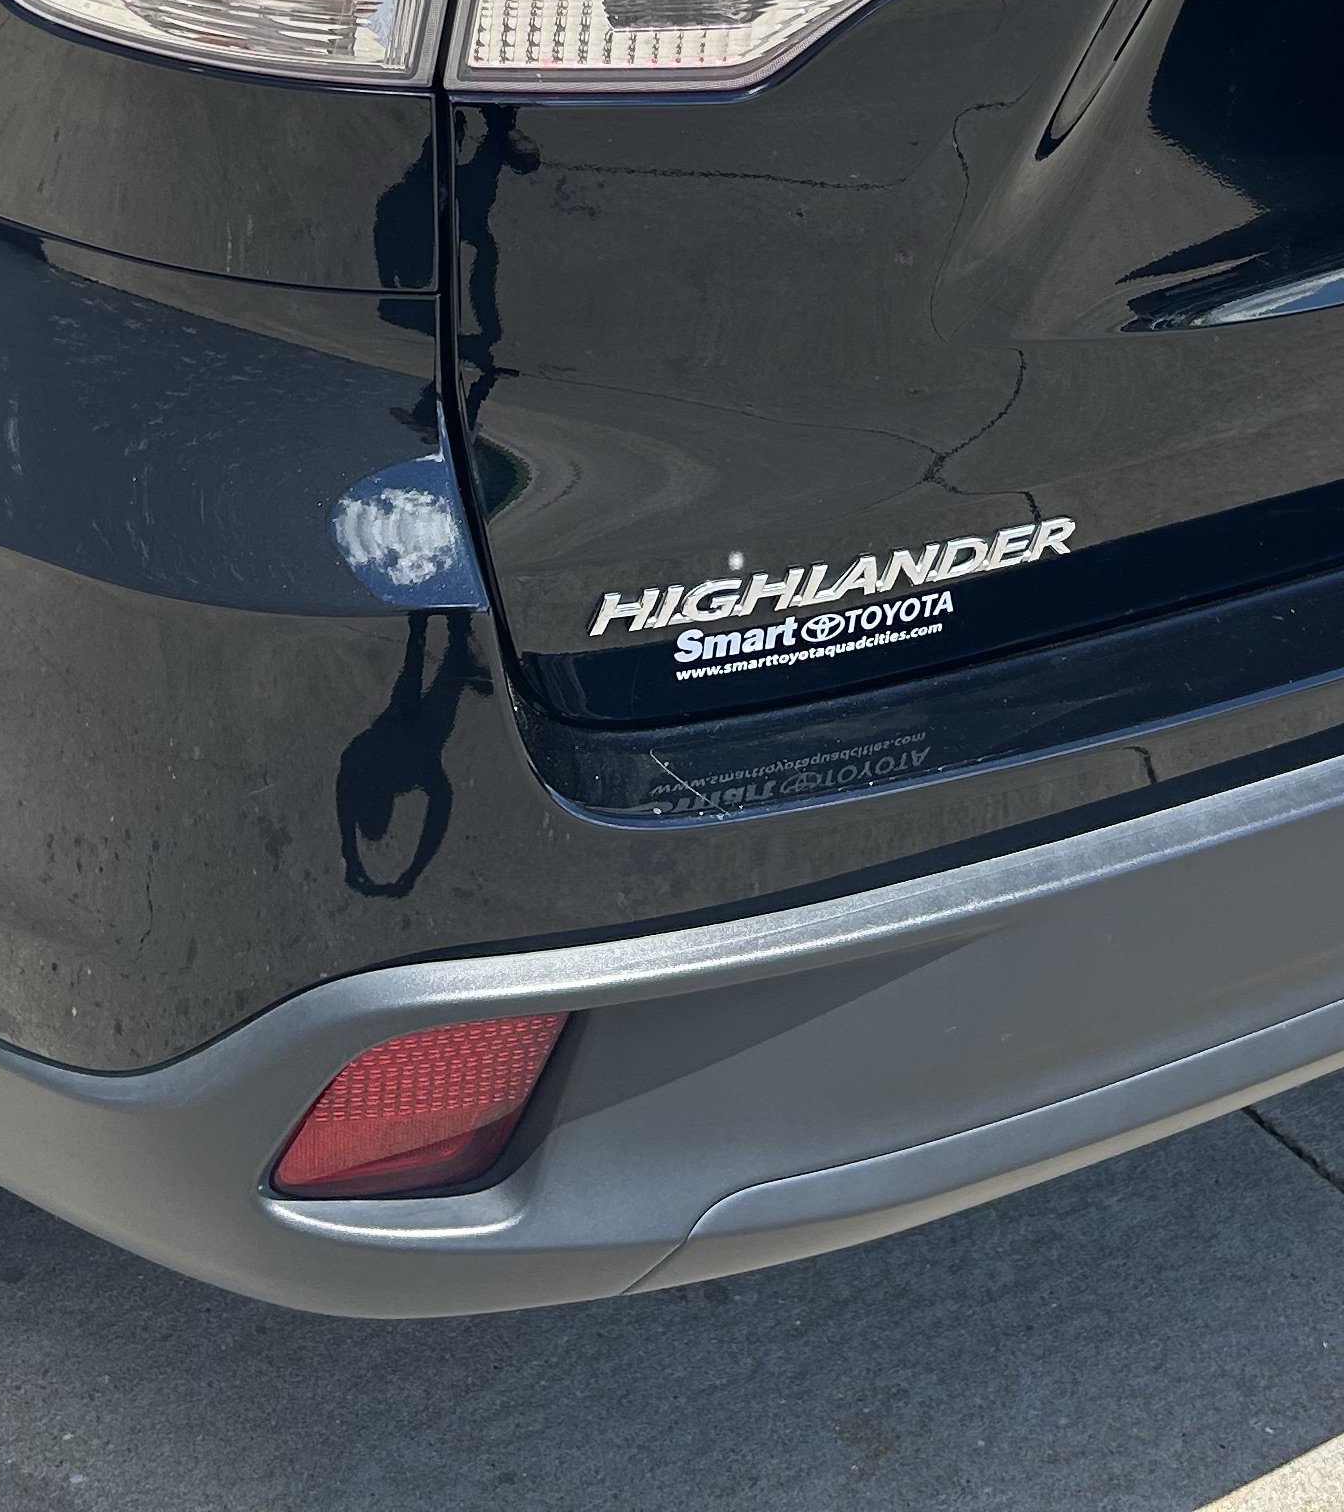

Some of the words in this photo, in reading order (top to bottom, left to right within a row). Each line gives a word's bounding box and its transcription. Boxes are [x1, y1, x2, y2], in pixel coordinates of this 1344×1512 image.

[589, 515, 1077, 637] HIGHLANDER
[673, 617, 798, 663] Smart
[844, 591, 954, 634] TOYOTA
[675, 622, 944, 681] www.smarttoyotaquadcities.com
